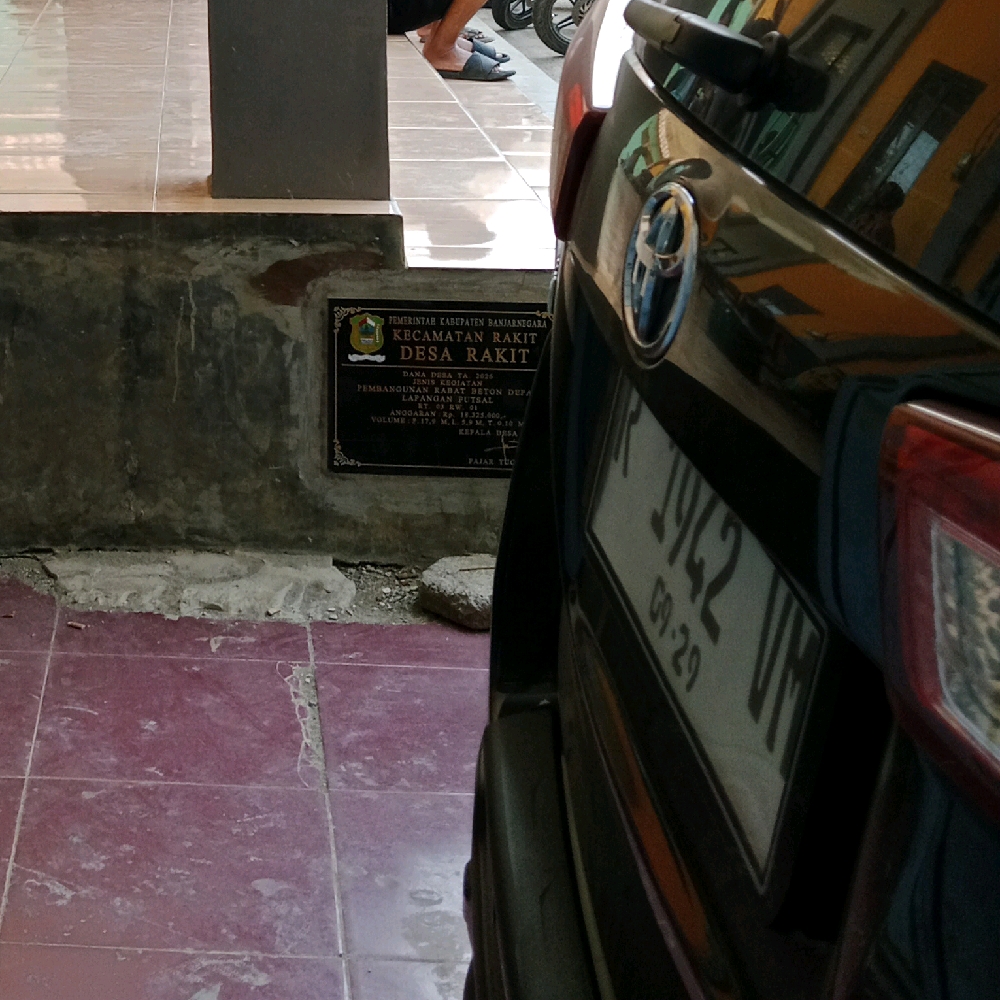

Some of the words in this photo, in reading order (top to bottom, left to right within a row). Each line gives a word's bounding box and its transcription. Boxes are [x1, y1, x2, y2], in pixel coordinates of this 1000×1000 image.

[388, 316, 436, 326] PEMERINTAH
[440, 317, 486, 327] KABUPATEN
[488, 318, 547, 328] BANJARNEGARA
[392, 329, 484, 343] KECAMATAN
[493, 332, 538, 344] RAKIT
[400, 346, 453, 361] DESA
[466, 348, 530, 364] RAKIT
[402, 370, 426, 378] DANA
[430, 371, 453, 379] DESA
[440, 379, 483, 387] KEGIATAN
[357, 385, 430, 394] PEMBANGUNAN
[434, 386, 466, 395] RABAT
[471, 387, 502, 396] BETON
[402, 395, 453, 403] LAPANGAN
[390, 409, 436, 417] ANGGARAN
[458, 428, 492, 436] KEPALA
